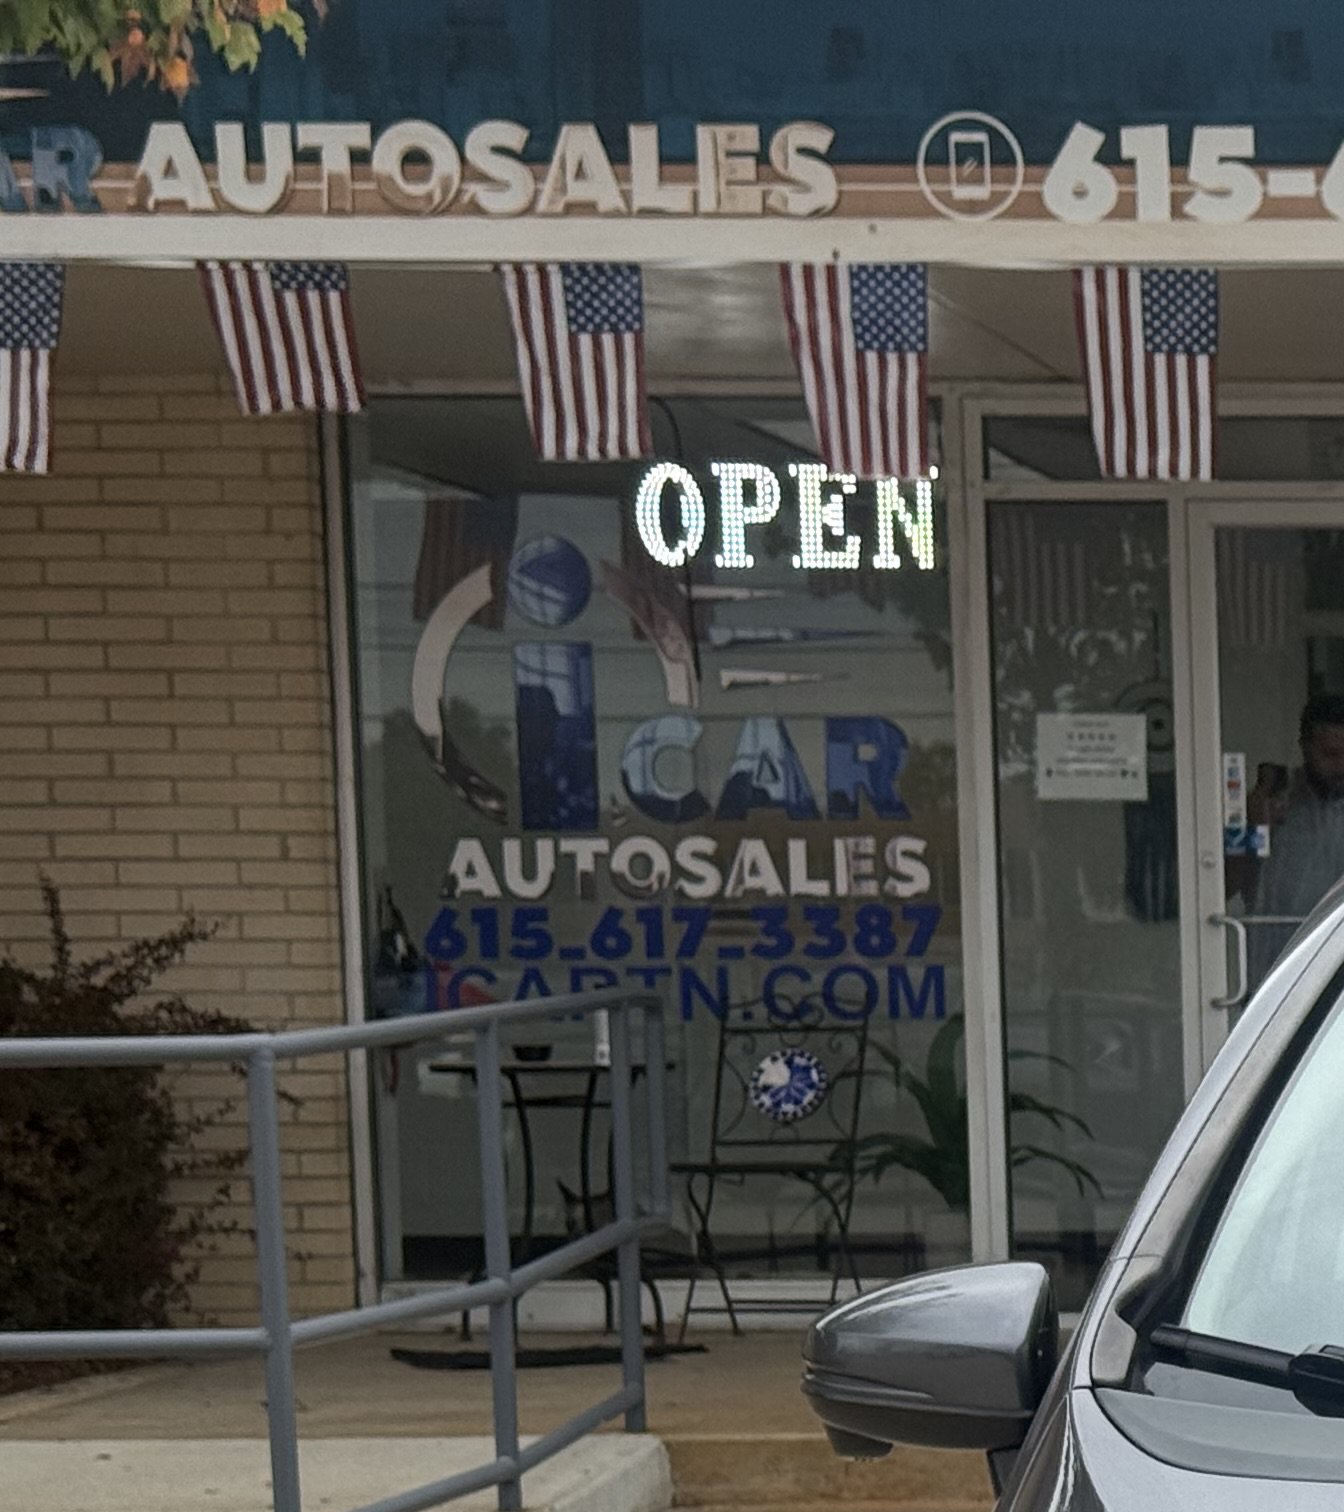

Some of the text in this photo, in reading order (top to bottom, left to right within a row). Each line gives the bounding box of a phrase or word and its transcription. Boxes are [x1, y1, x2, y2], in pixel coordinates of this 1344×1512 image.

[135, 120, 838, 217] AUTOSALES
[634, 461, 940, 571] OPEN
[439, 836, 933, 900] AUTOSALES
